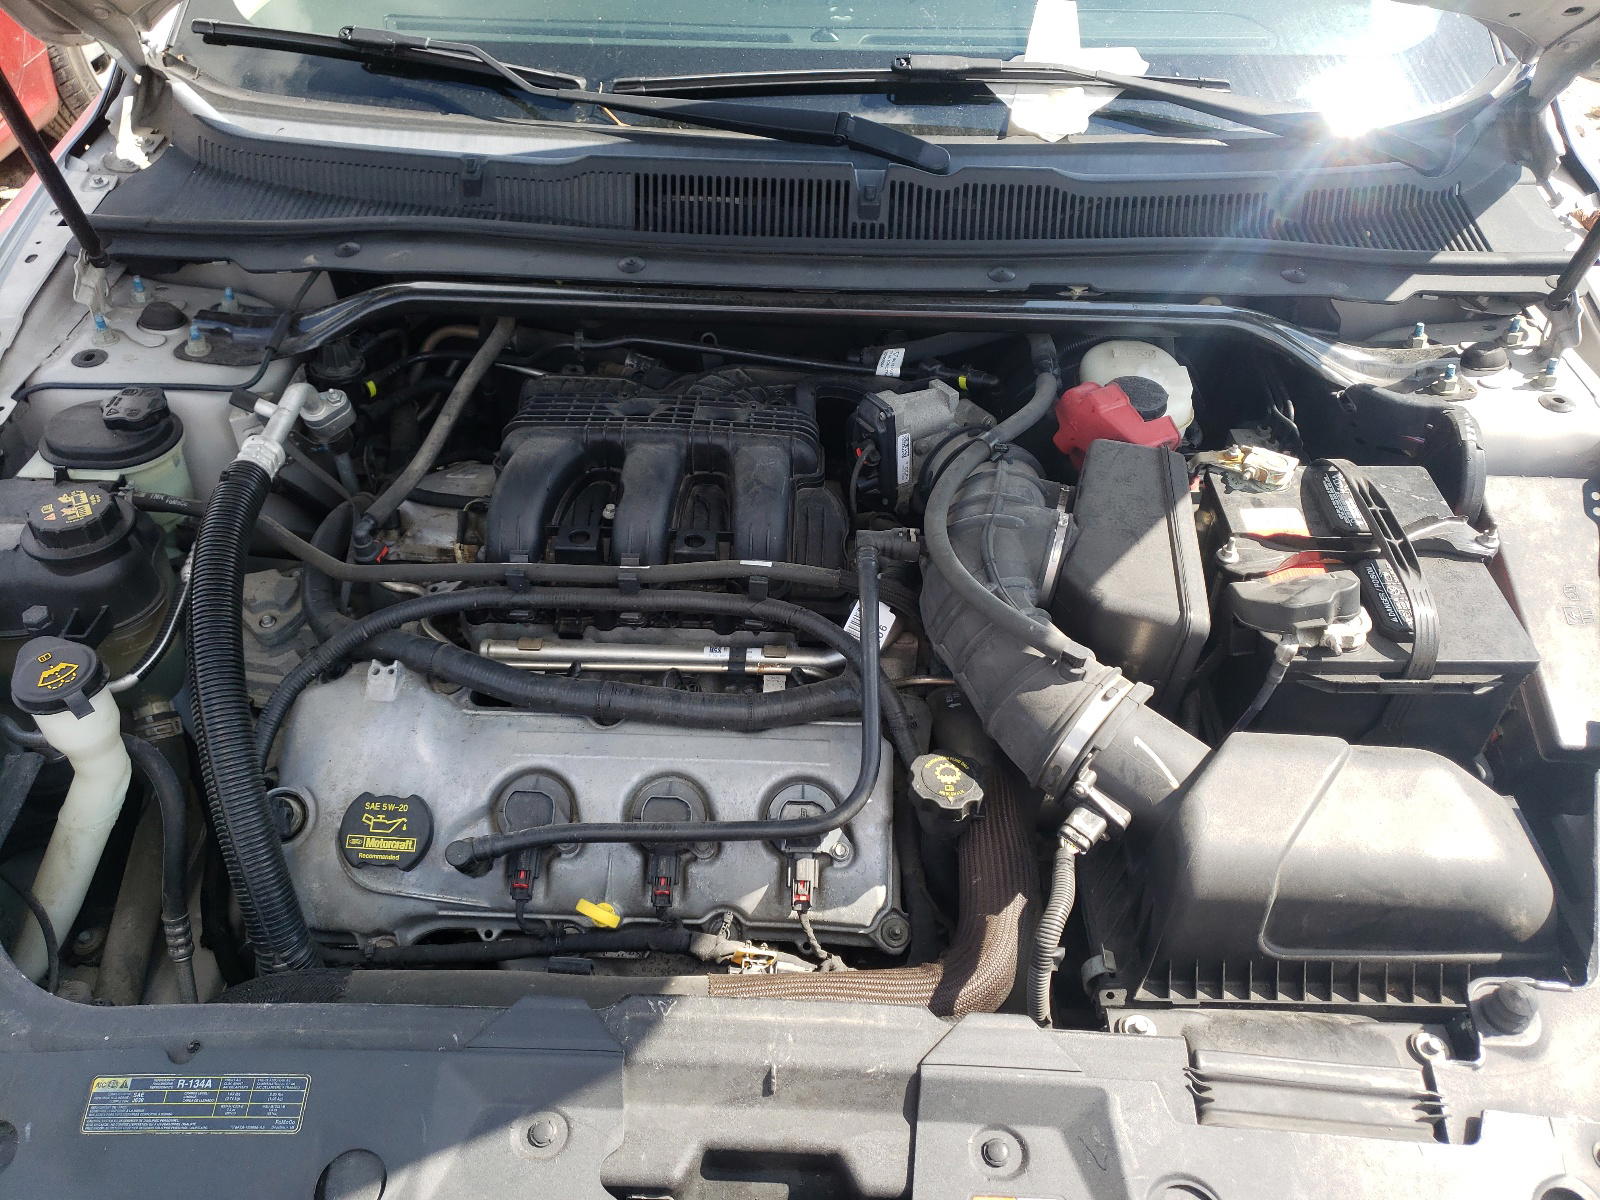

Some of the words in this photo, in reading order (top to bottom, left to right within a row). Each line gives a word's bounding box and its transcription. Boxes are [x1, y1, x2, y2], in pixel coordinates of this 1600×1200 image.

[364, 802, 381, 811] SAE
[382, 803, 409, 812] 5W-20
[365, 837, 414, 850] Motorcraft
[358, 852, 400, 861] Recommended
[176, 1078, 213, 1089] R-134A
